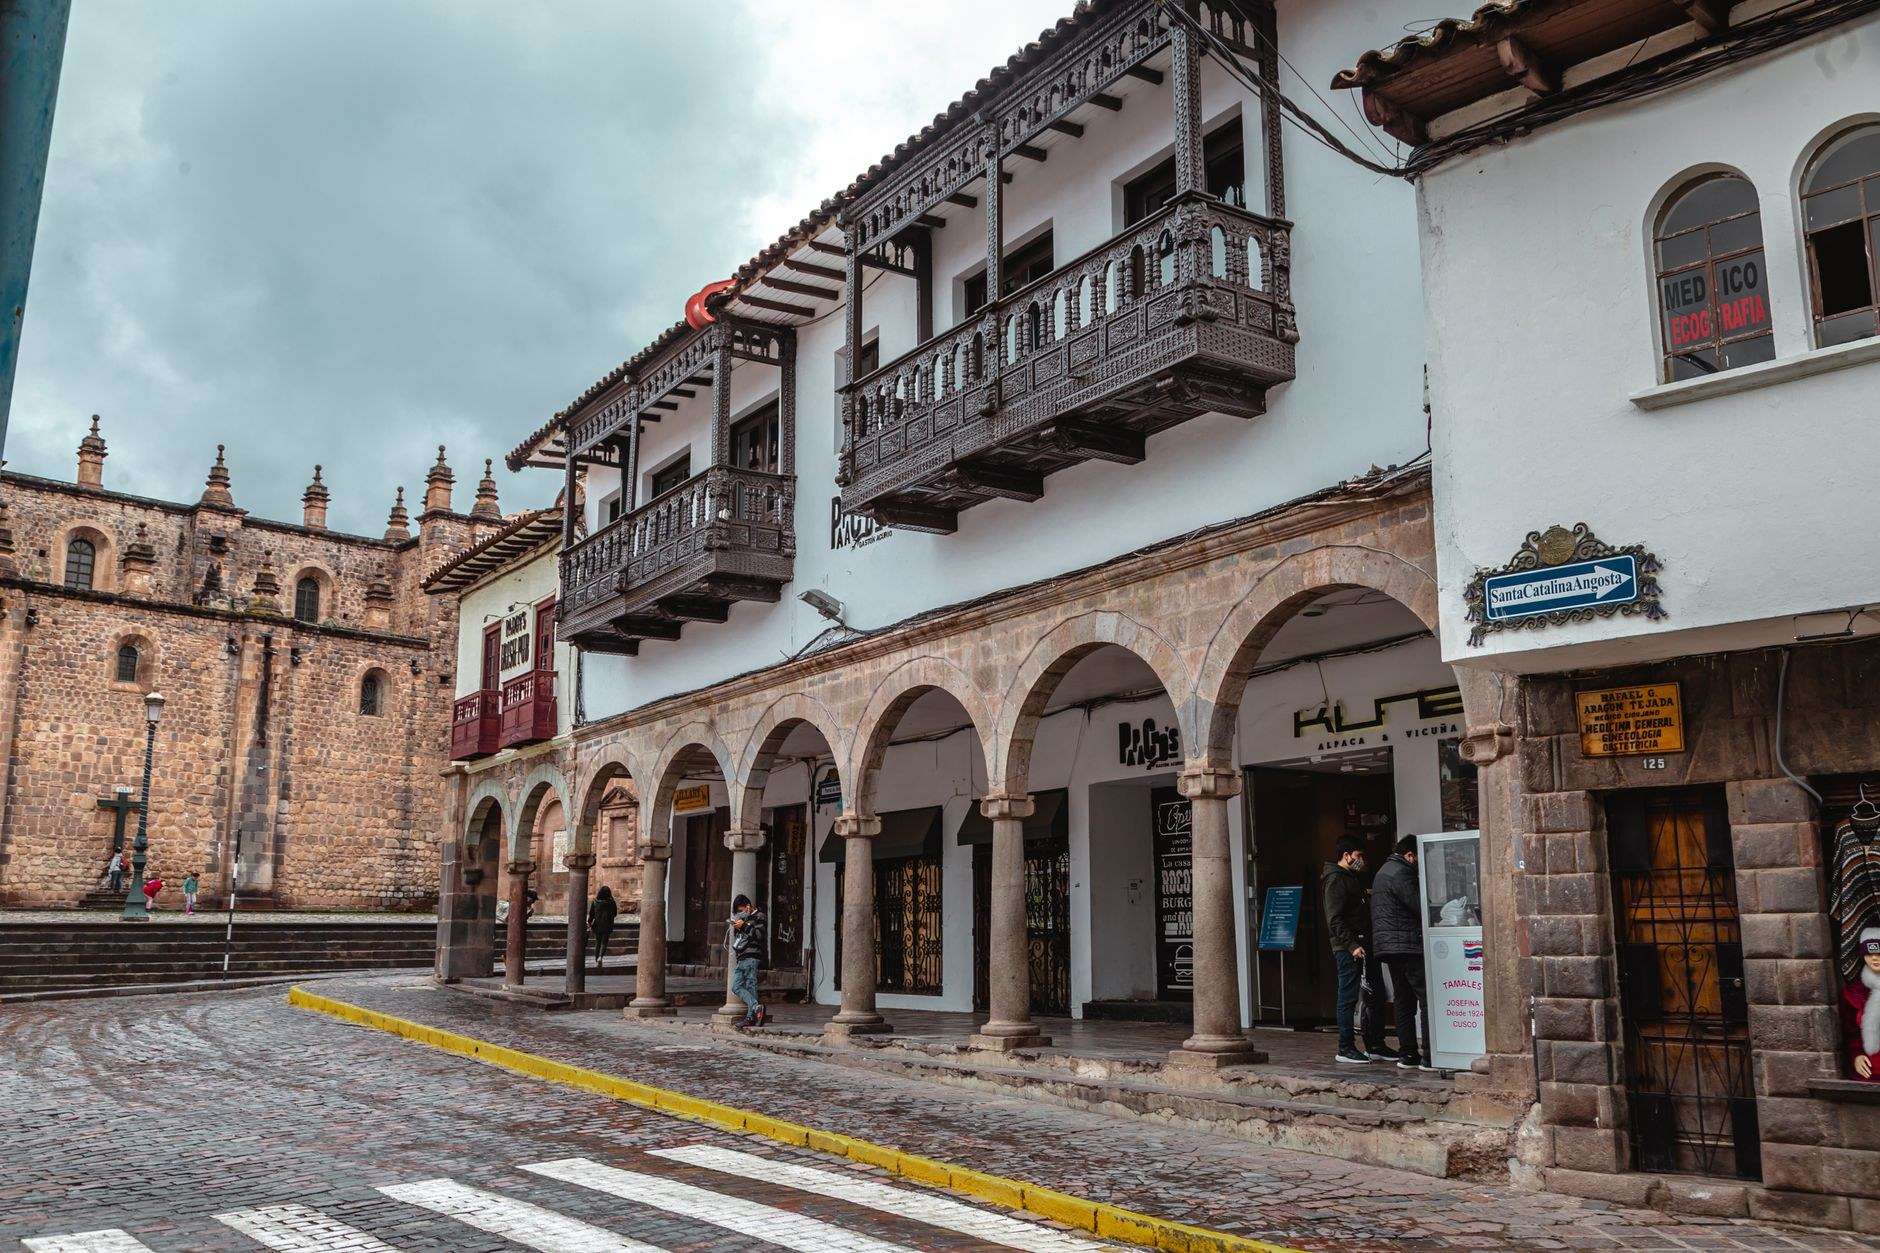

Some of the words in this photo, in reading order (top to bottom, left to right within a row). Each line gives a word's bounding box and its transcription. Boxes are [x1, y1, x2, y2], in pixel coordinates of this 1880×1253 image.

[1664, 261, 1758, 311] MEDICO
[1670, 294, 1766, 345] ECOGRAFIA
[1601, 690, 1643, 702] RAFAEL
[1629, 698, 1674, 709] TEJADA
[1585, 721, 1631, 734] MEDICINA
[1635, 717, 1674, 729] GENERAL
[1318, 737, 1365, 751] ALPACA
[1382, 734, 1389, 742] &
[1405, 723, 1458, 738] VICUÑA
[1602, 729, 1662, 743] GINECOLOGIA
[1603, 740, 1658, 752] OBSTETRICIA
[1643, 758, 1665, 769] 125
[1442, 979, 1483, 991] TAMALES
[1446, 999, 1480, 1007] JOSEFINA
[1446, 1009, 1467, 1017] Desde
[1468, 1009, 1484, 1017] 1924
[1452, 1020, 1477, 1029] CUSCO
